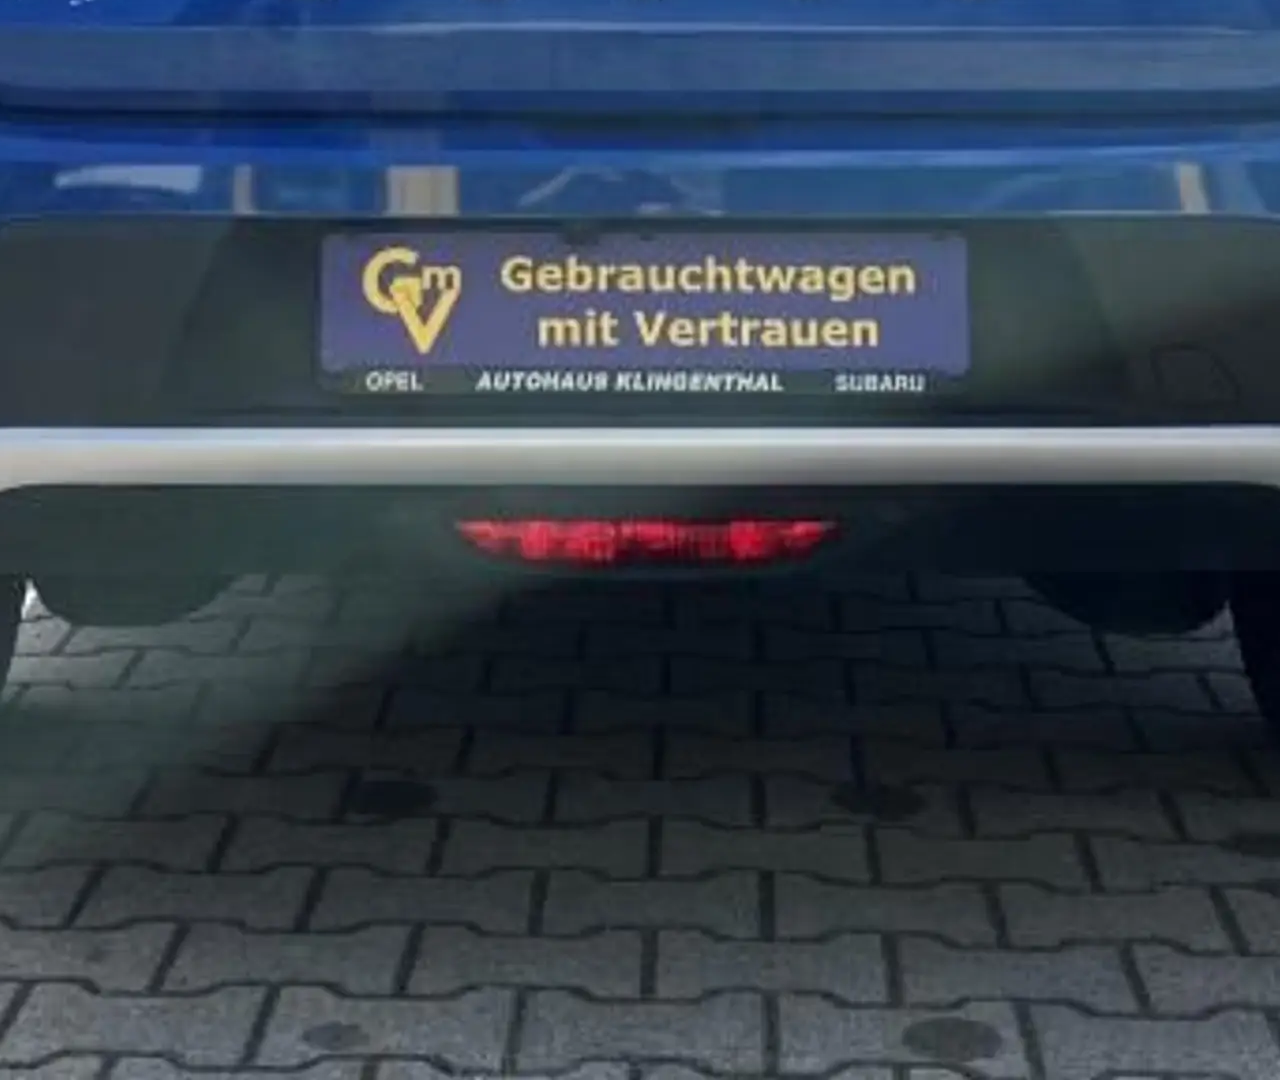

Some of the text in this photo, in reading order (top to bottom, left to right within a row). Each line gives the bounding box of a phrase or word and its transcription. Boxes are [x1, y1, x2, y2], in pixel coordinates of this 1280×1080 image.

[501, 255, 917, 302] Gebrauchtwagen
[538, 311, 880, 348] mit Vertrauen
[365, 370, 424, 392] OPEL
[475, 371, 784, 392] AUTOHAUS KLINGENTHAL
[834, 373, 927, 393] SUBARU
